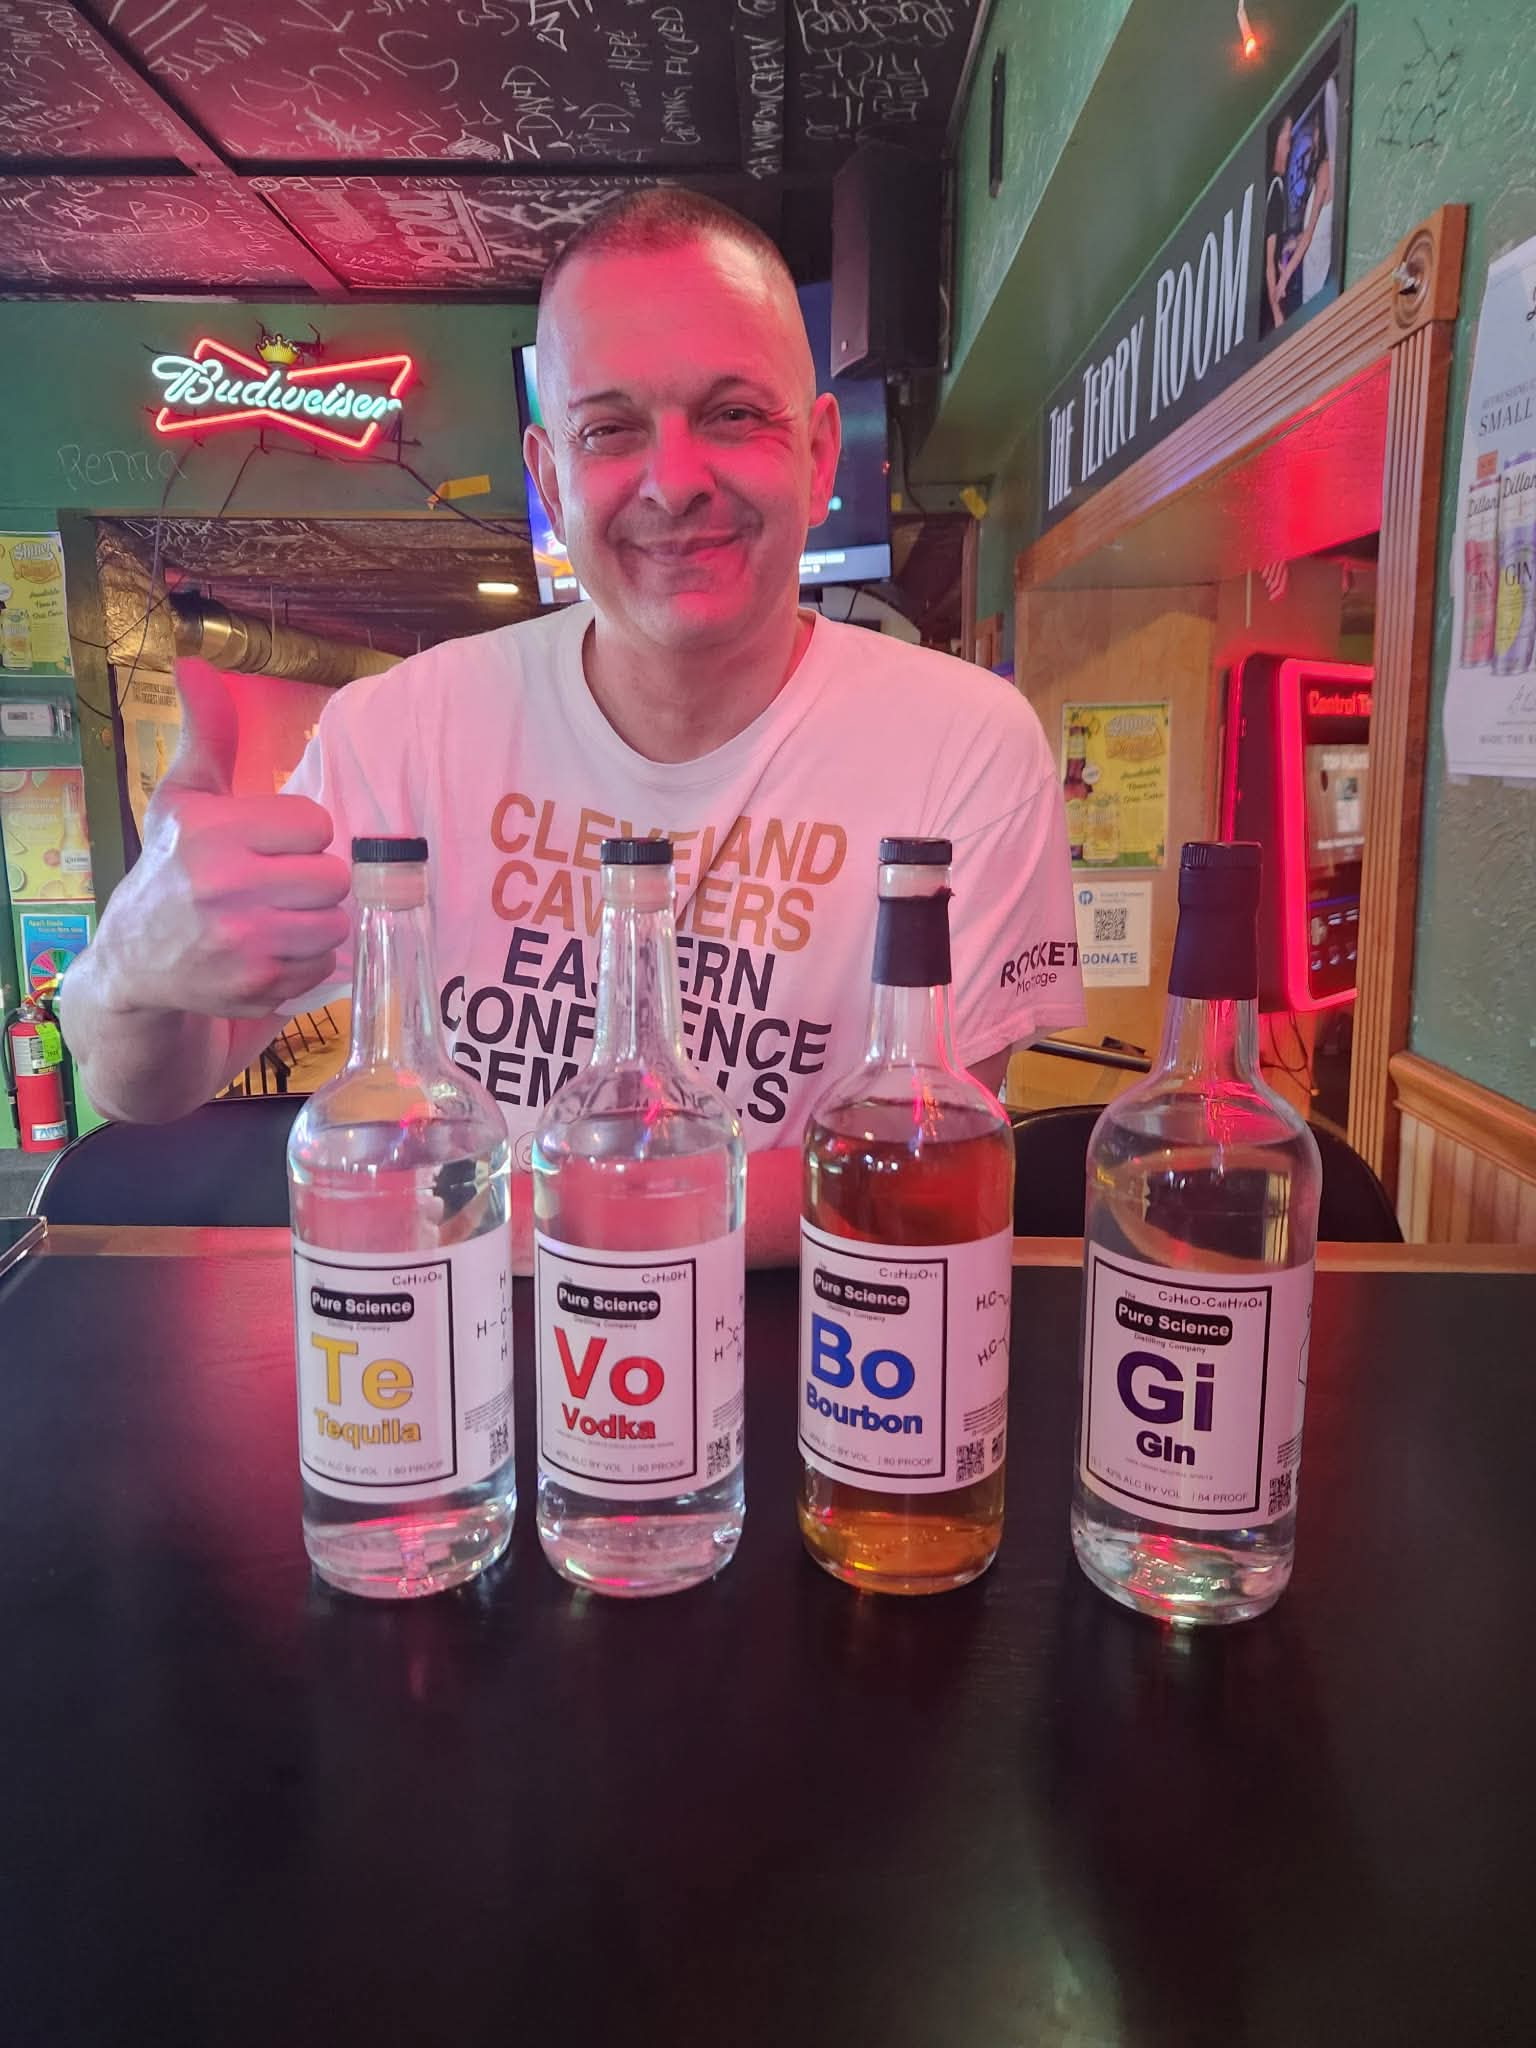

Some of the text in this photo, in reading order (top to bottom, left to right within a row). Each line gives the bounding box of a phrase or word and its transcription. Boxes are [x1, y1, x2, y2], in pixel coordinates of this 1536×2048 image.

[1048, 183, 1254, 511] THE TERRY ROOM
[152, 354, 402, 421] Budweiser
[1478, 397, 1533, 437] SMALL
[1505, 561, 1533, 586] GIN
[1000, 941, 1079, 988] ROCKET
[1082, 952, 1138, 966] DONATE
[311, 1291, 412, 1315] Pure Science
[558, 1287, 659, 1313] Pure Science
[814, 1272, 908, 1307] Pure Science
[1117, 1302, 1230, 1337] Pure Science
[553, 1325, 665, 1406] Vo
[811, 1311, 916, 1400] Bo
[1168, 1341, 1206, 1354] Company
[311, 1333, 414, 1410] Te
[806, 1379, 923, 1435] Bourbon
[1116, 1350, 1215, 1433] Gi
[314, 1407, 422, 1450] Tequila
[561, 1402, 657, 1440] Vodka
[650, 1459, 685, 1473] PROOF
[897, 1456, 934, 1467] PROOF
[1135, 1430, 1196, 1466] Gin
[1124, 1476, 1142, 1490] ALC
[1144, 1484, 1158, 1494] BY
[1159, 1488, 1181, 1499] VOL
[1212, 1491, 1249, 1504] PROOF
